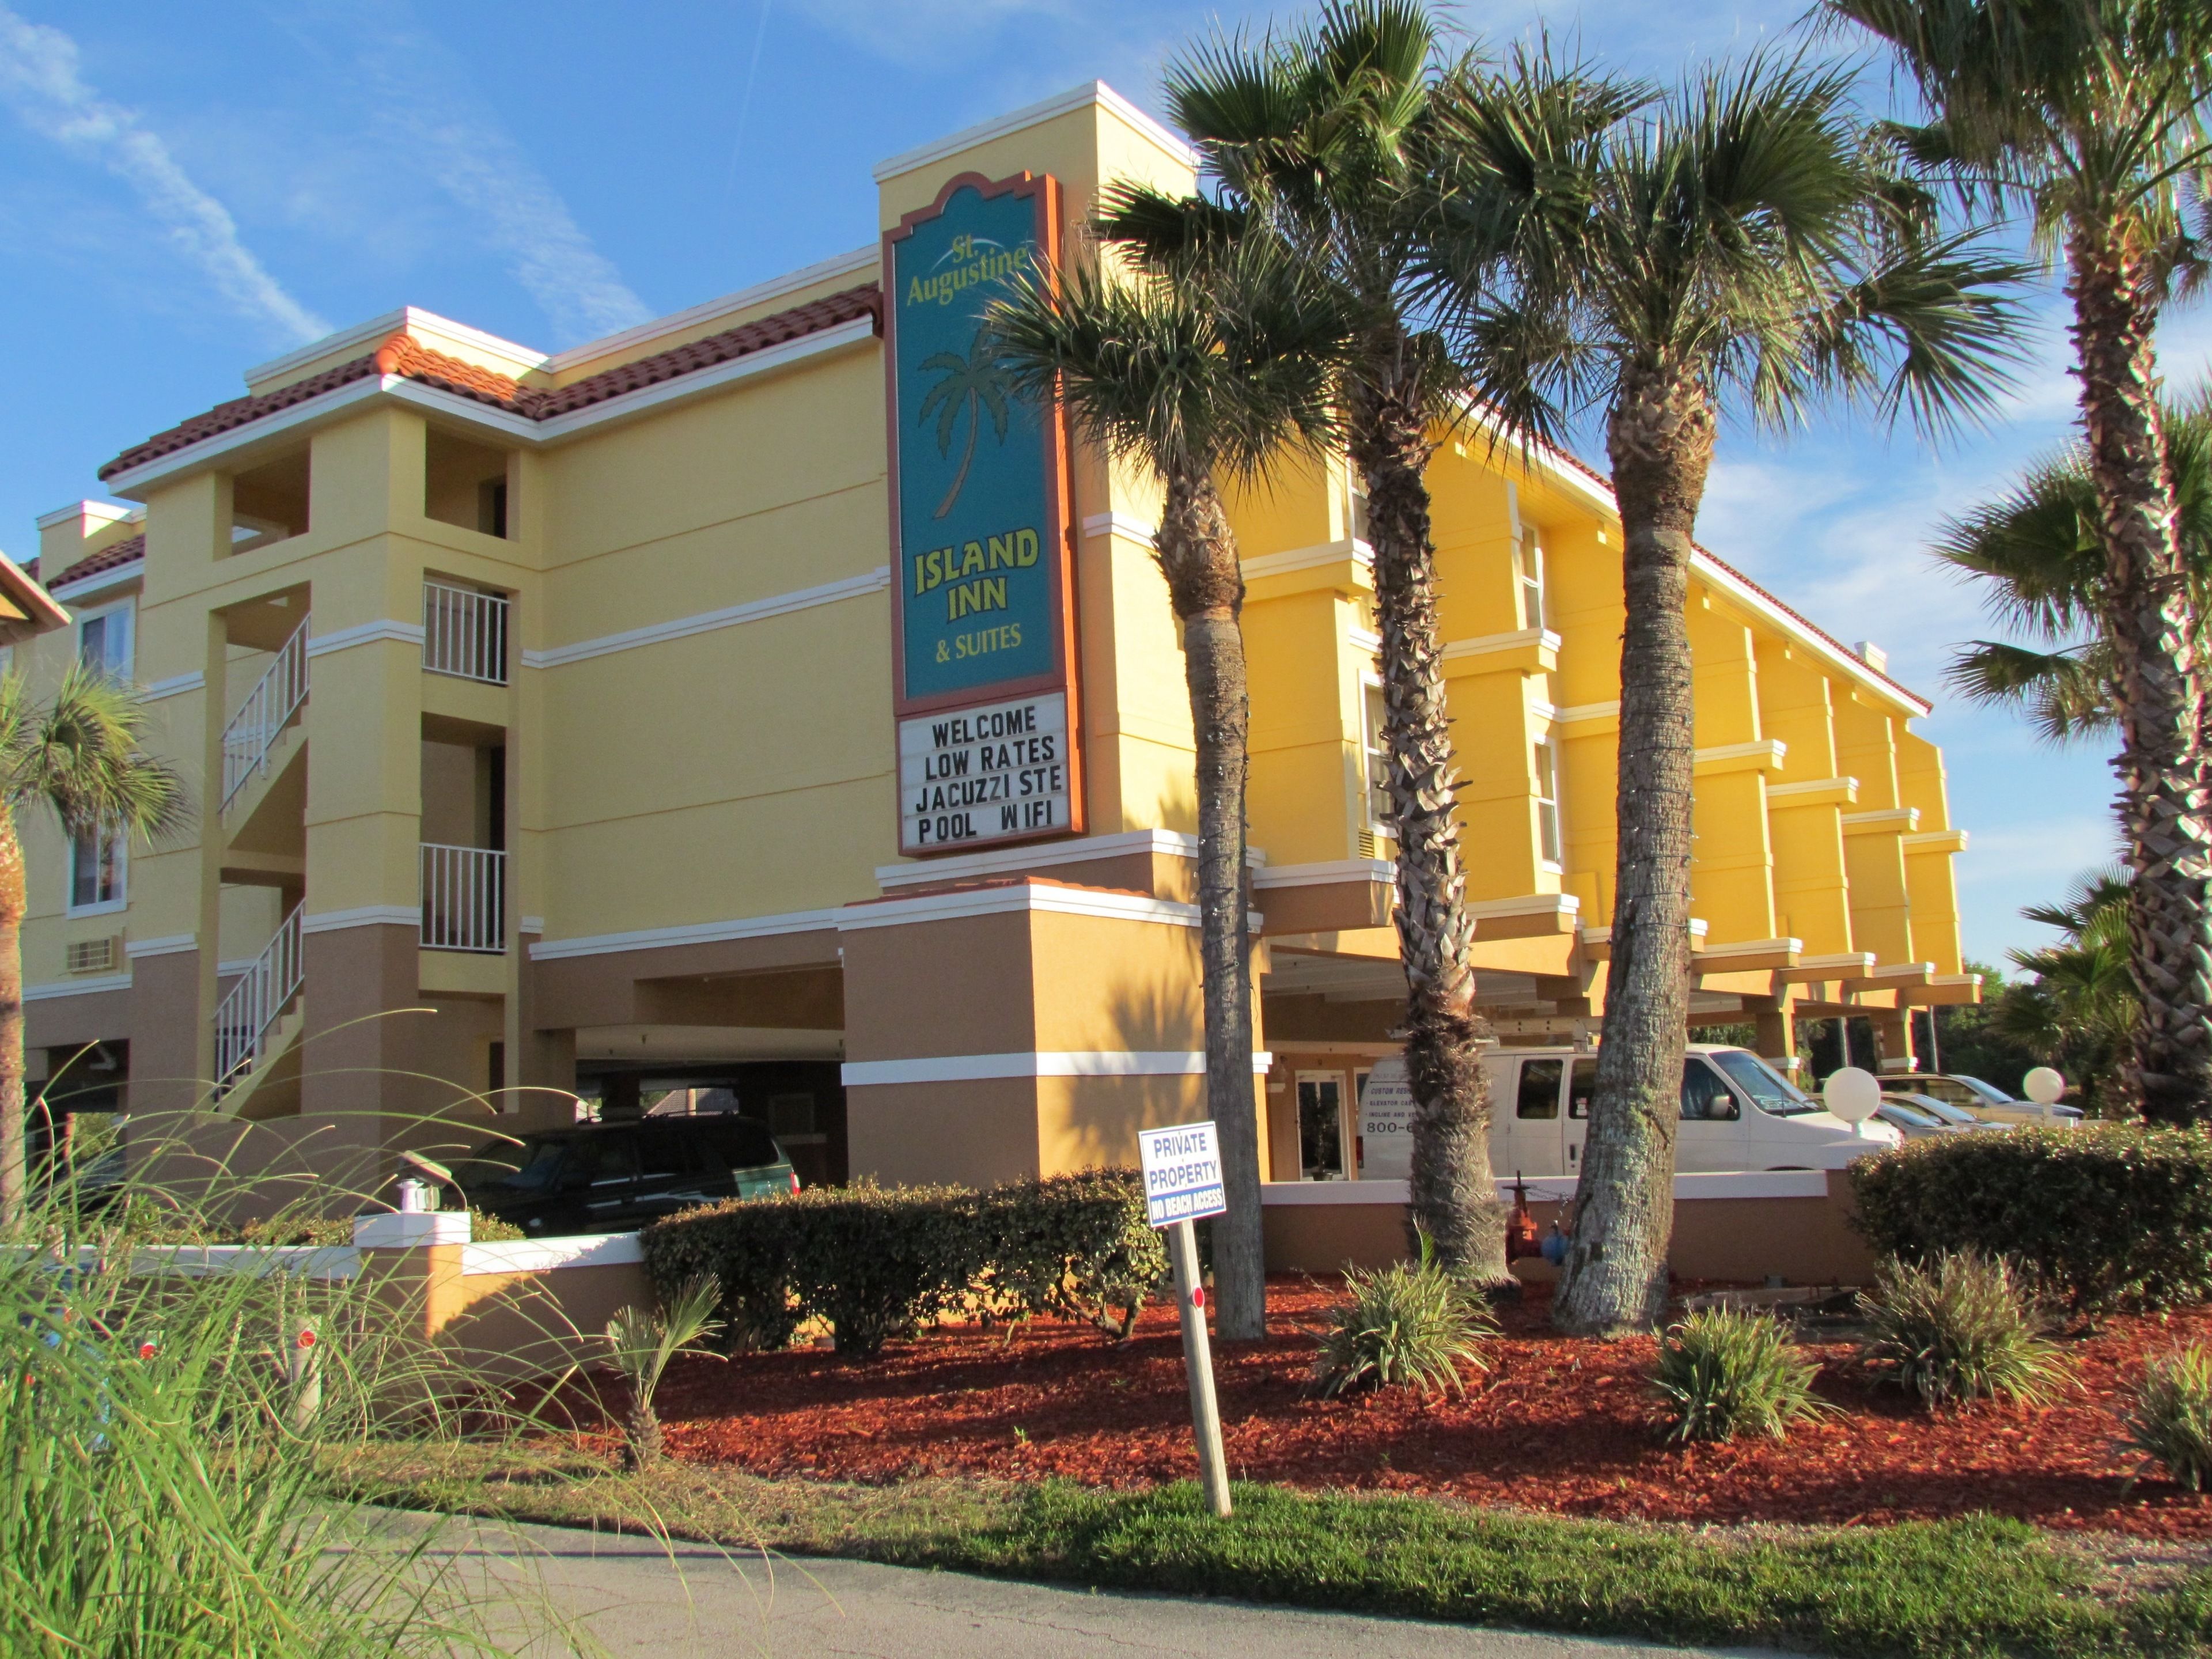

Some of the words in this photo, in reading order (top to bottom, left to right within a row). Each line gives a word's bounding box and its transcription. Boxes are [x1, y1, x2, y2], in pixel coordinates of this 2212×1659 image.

[952, 233, 979, 263] St.
[906, 247, 1028, 307] Augustine
[914, 527, 1040, 597] ISLAND
[946, 577, 1007, 624] INN
[936, 639, 950, 662] &
[956, 623, 1022, 659] SUITES
[932, 706, 1036, 748] WELCOME
[925, 750, 969, 781] LOW
[981, 736, 1054, 771] RATES
[916, 774, 1009, 812] JACUZZI
[1019, 765, 1062, 796] STE
[919, 813, 976, 843] POOL
[1001, 800, 1052, 830] WIFI
[1154, 1132, 1207, 1158] PRIVATE
[1149, 1160, 1217, 1190] PROPERTY
[1151, 1199, 1164, 1220] NO
[1165, 1194, 1193, 1217] BEACH
[1193, 1188, 1223, 1211] ACCESS
